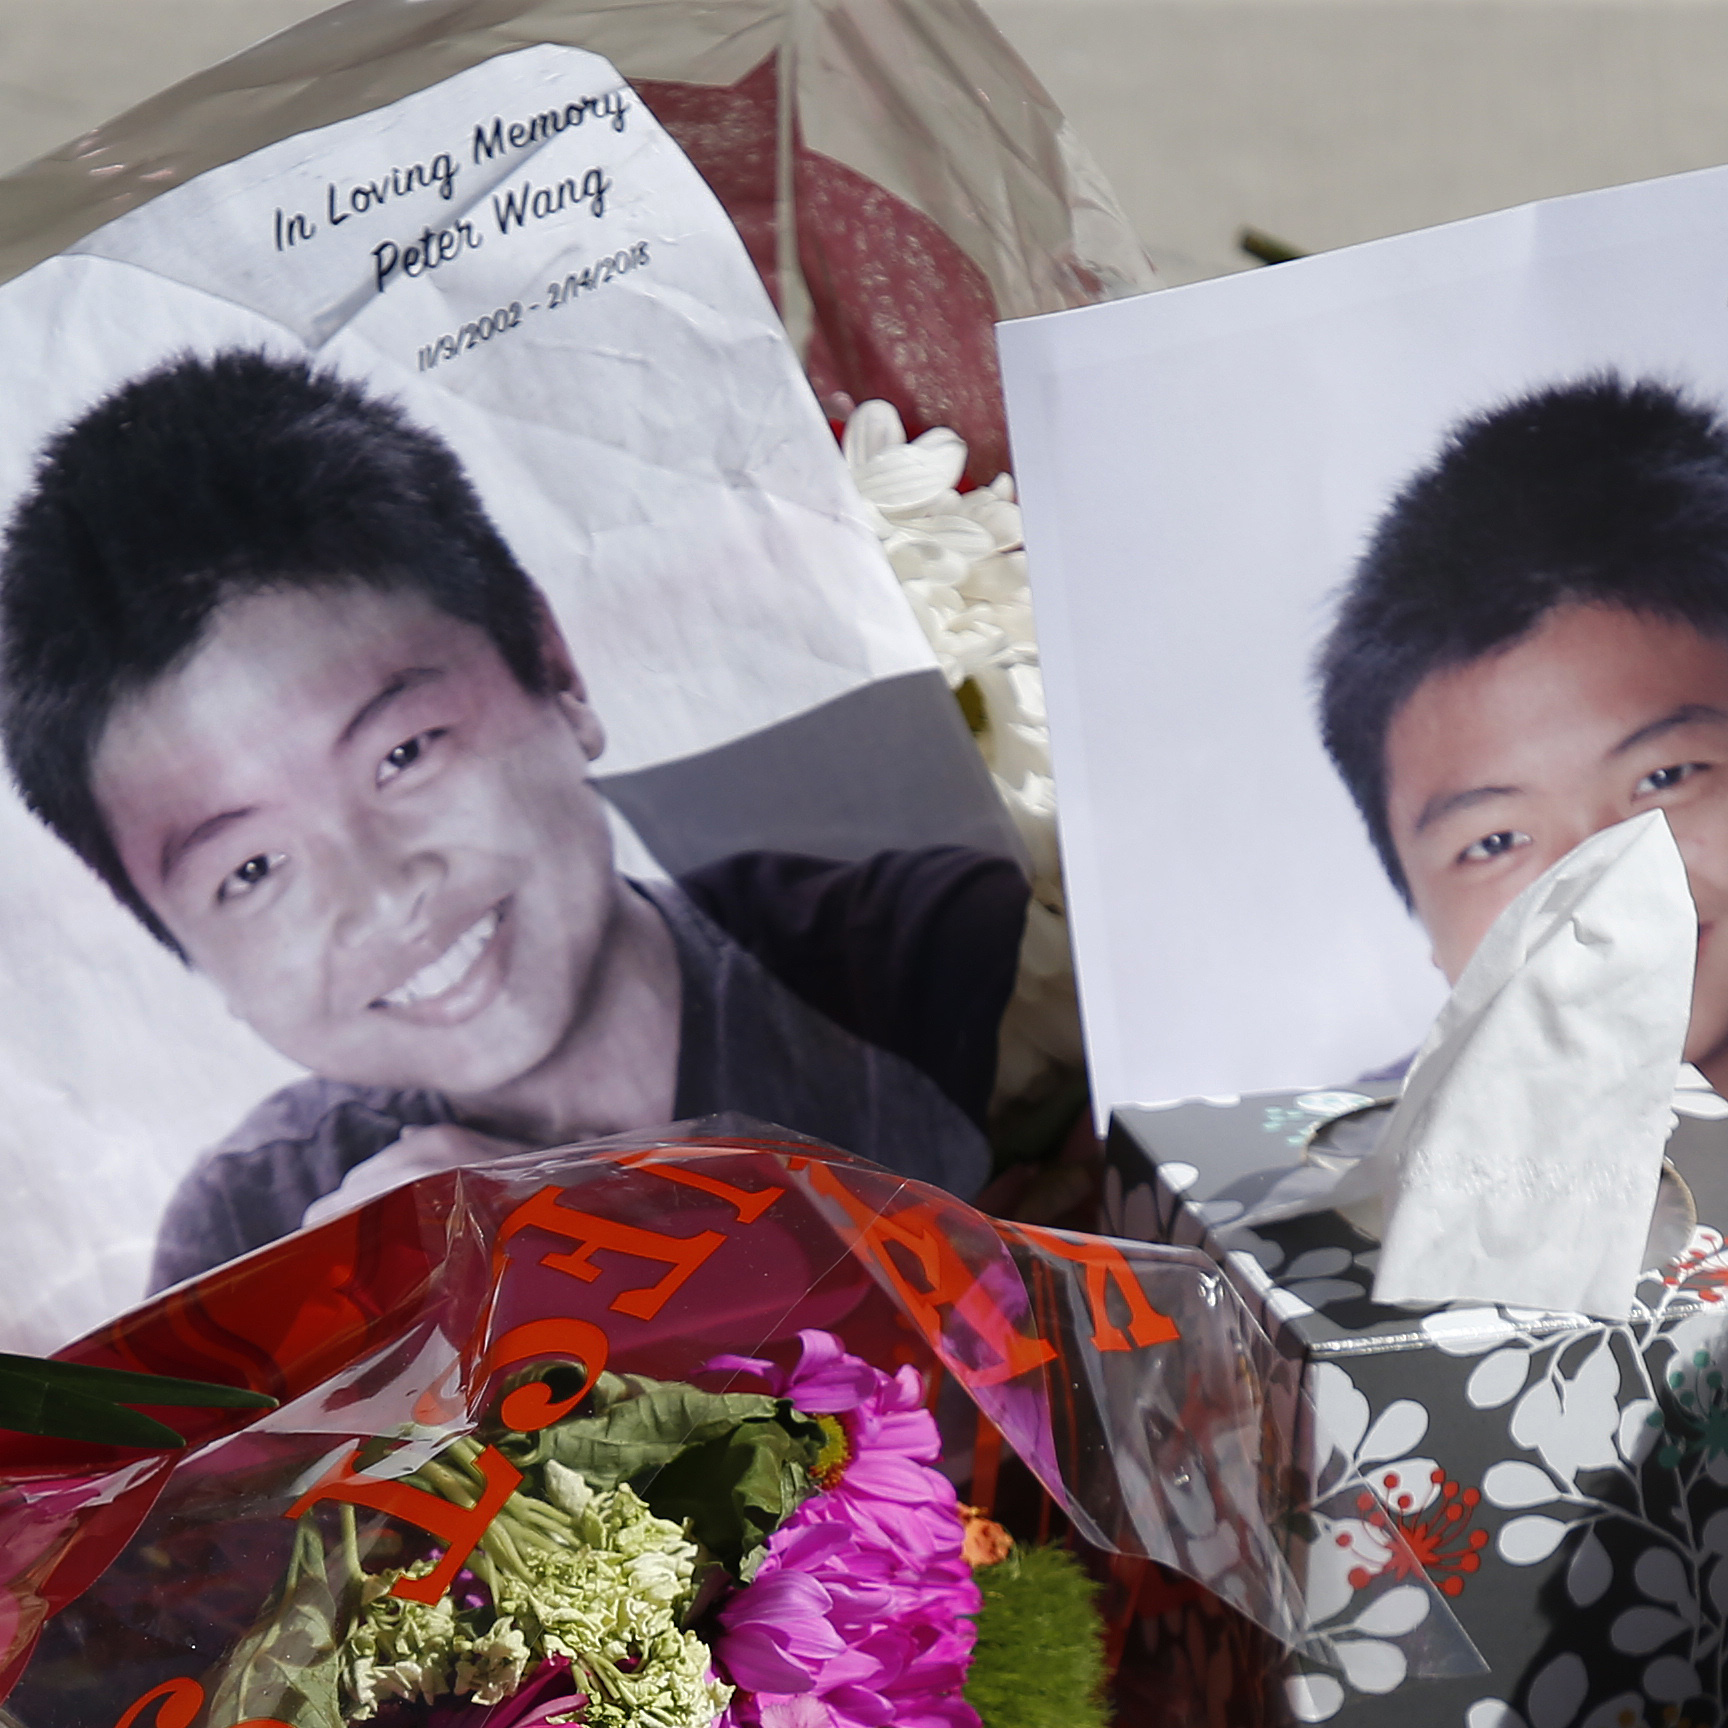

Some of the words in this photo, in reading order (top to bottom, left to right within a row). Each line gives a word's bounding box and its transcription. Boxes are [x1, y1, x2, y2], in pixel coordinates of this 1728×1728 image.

[274, 207, 316, 251] In
[327, 152, 459, 225] Loving
[472, 91, 628, 165] Memory
[371, 219, 482, 293] Peter
[492, 166, 612, 234] Wang
